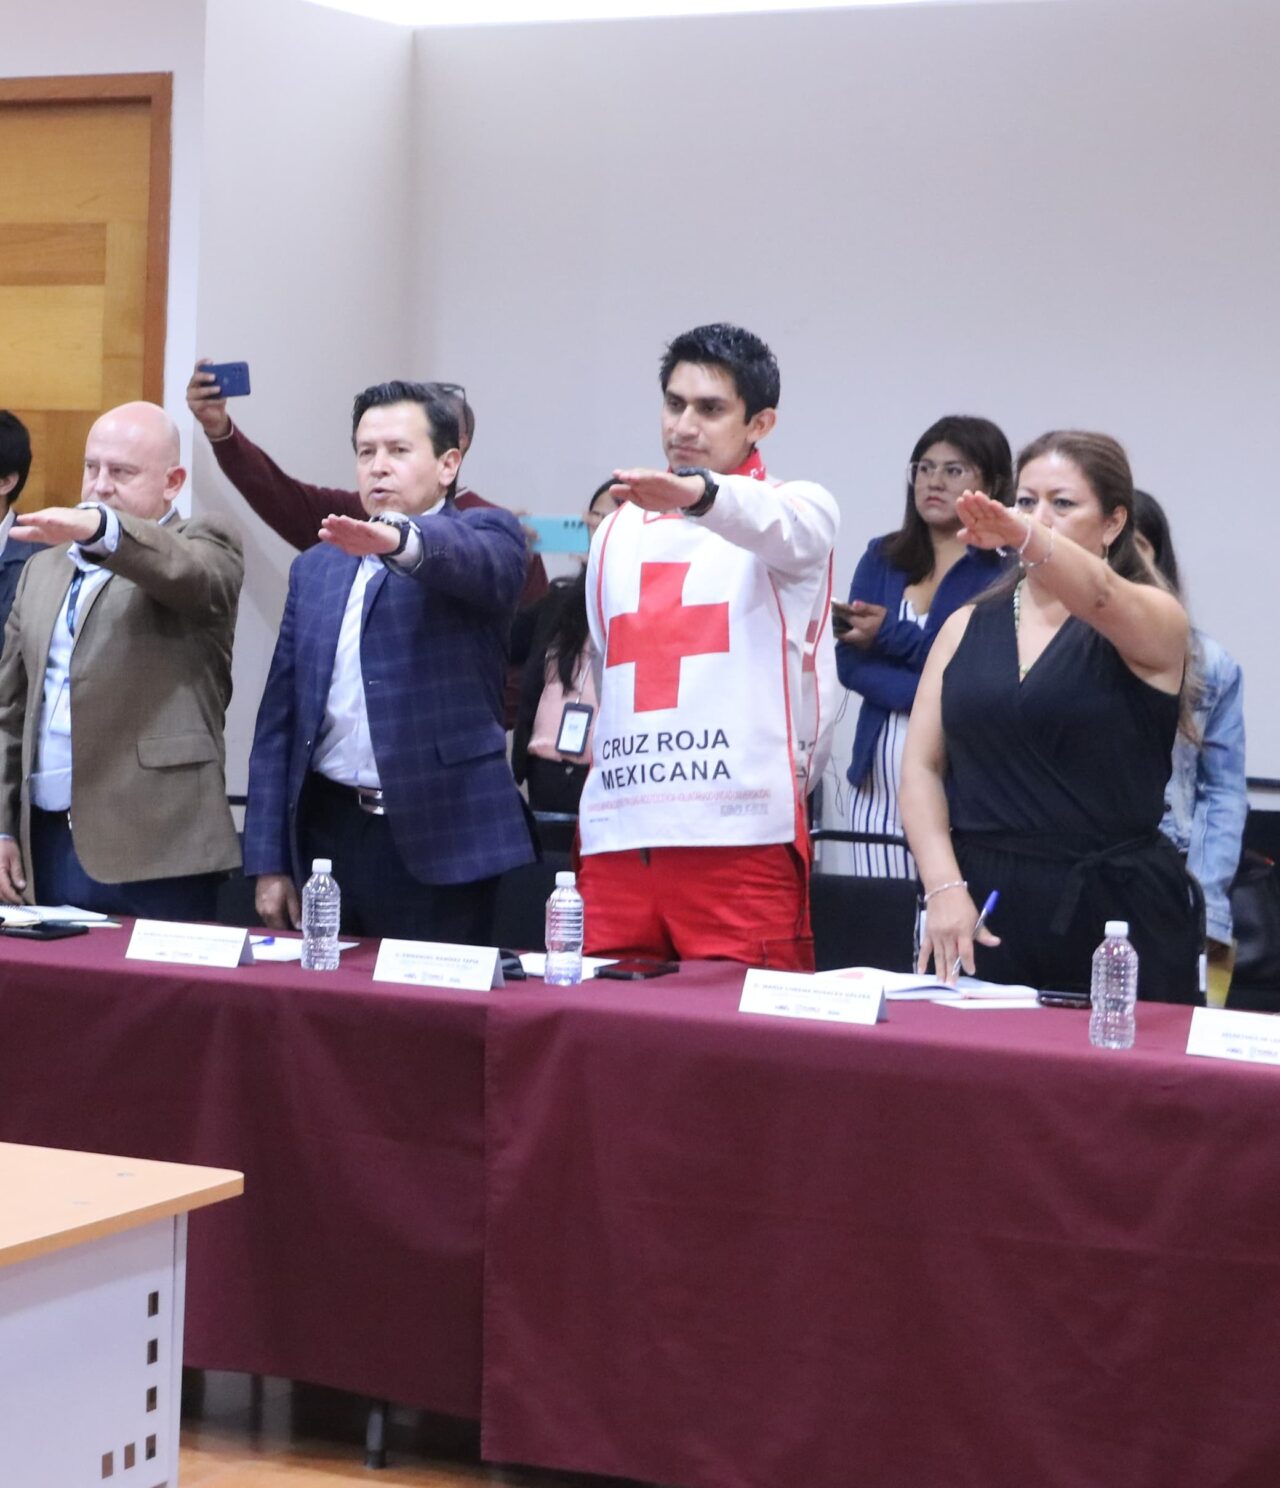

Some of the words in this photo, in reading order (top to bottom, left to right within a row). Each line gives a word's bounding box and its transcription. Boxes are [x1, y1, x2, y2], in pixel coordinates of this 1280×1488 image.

[602, 734, 649, 760] CRUZ
[657, 728, 730, 752] ROJA
[601, 759, 731, 790] MEXICANA
